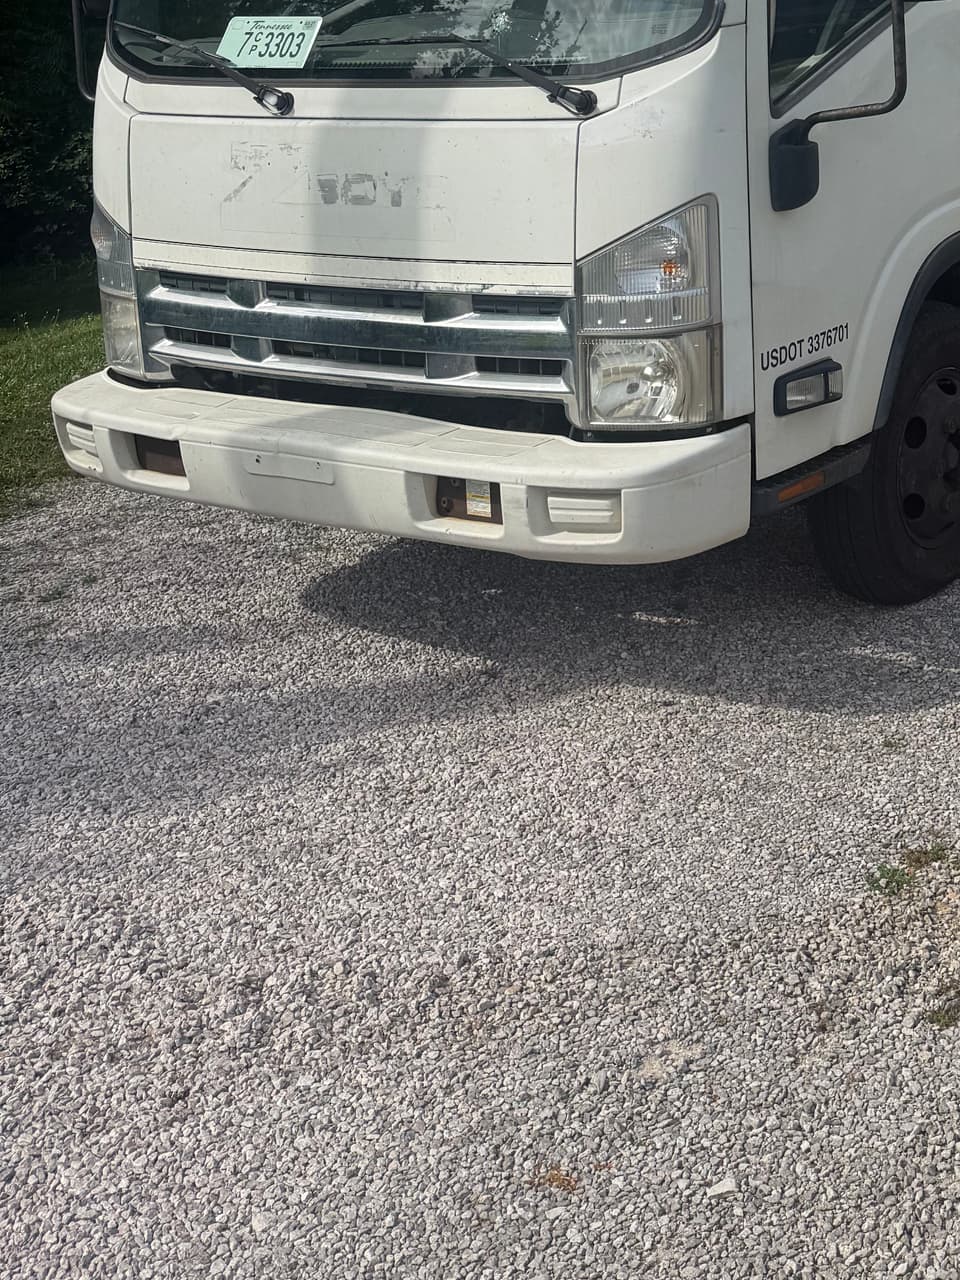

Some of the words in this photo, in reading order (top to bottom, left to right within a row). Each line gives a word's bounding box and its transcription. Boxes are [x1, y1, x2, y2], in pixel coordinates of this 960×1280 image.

[249, 20, 294, 32] Tennessee
[760, 338, 805, 371] USDOT
[807, 322, 849, 354] 3376701
